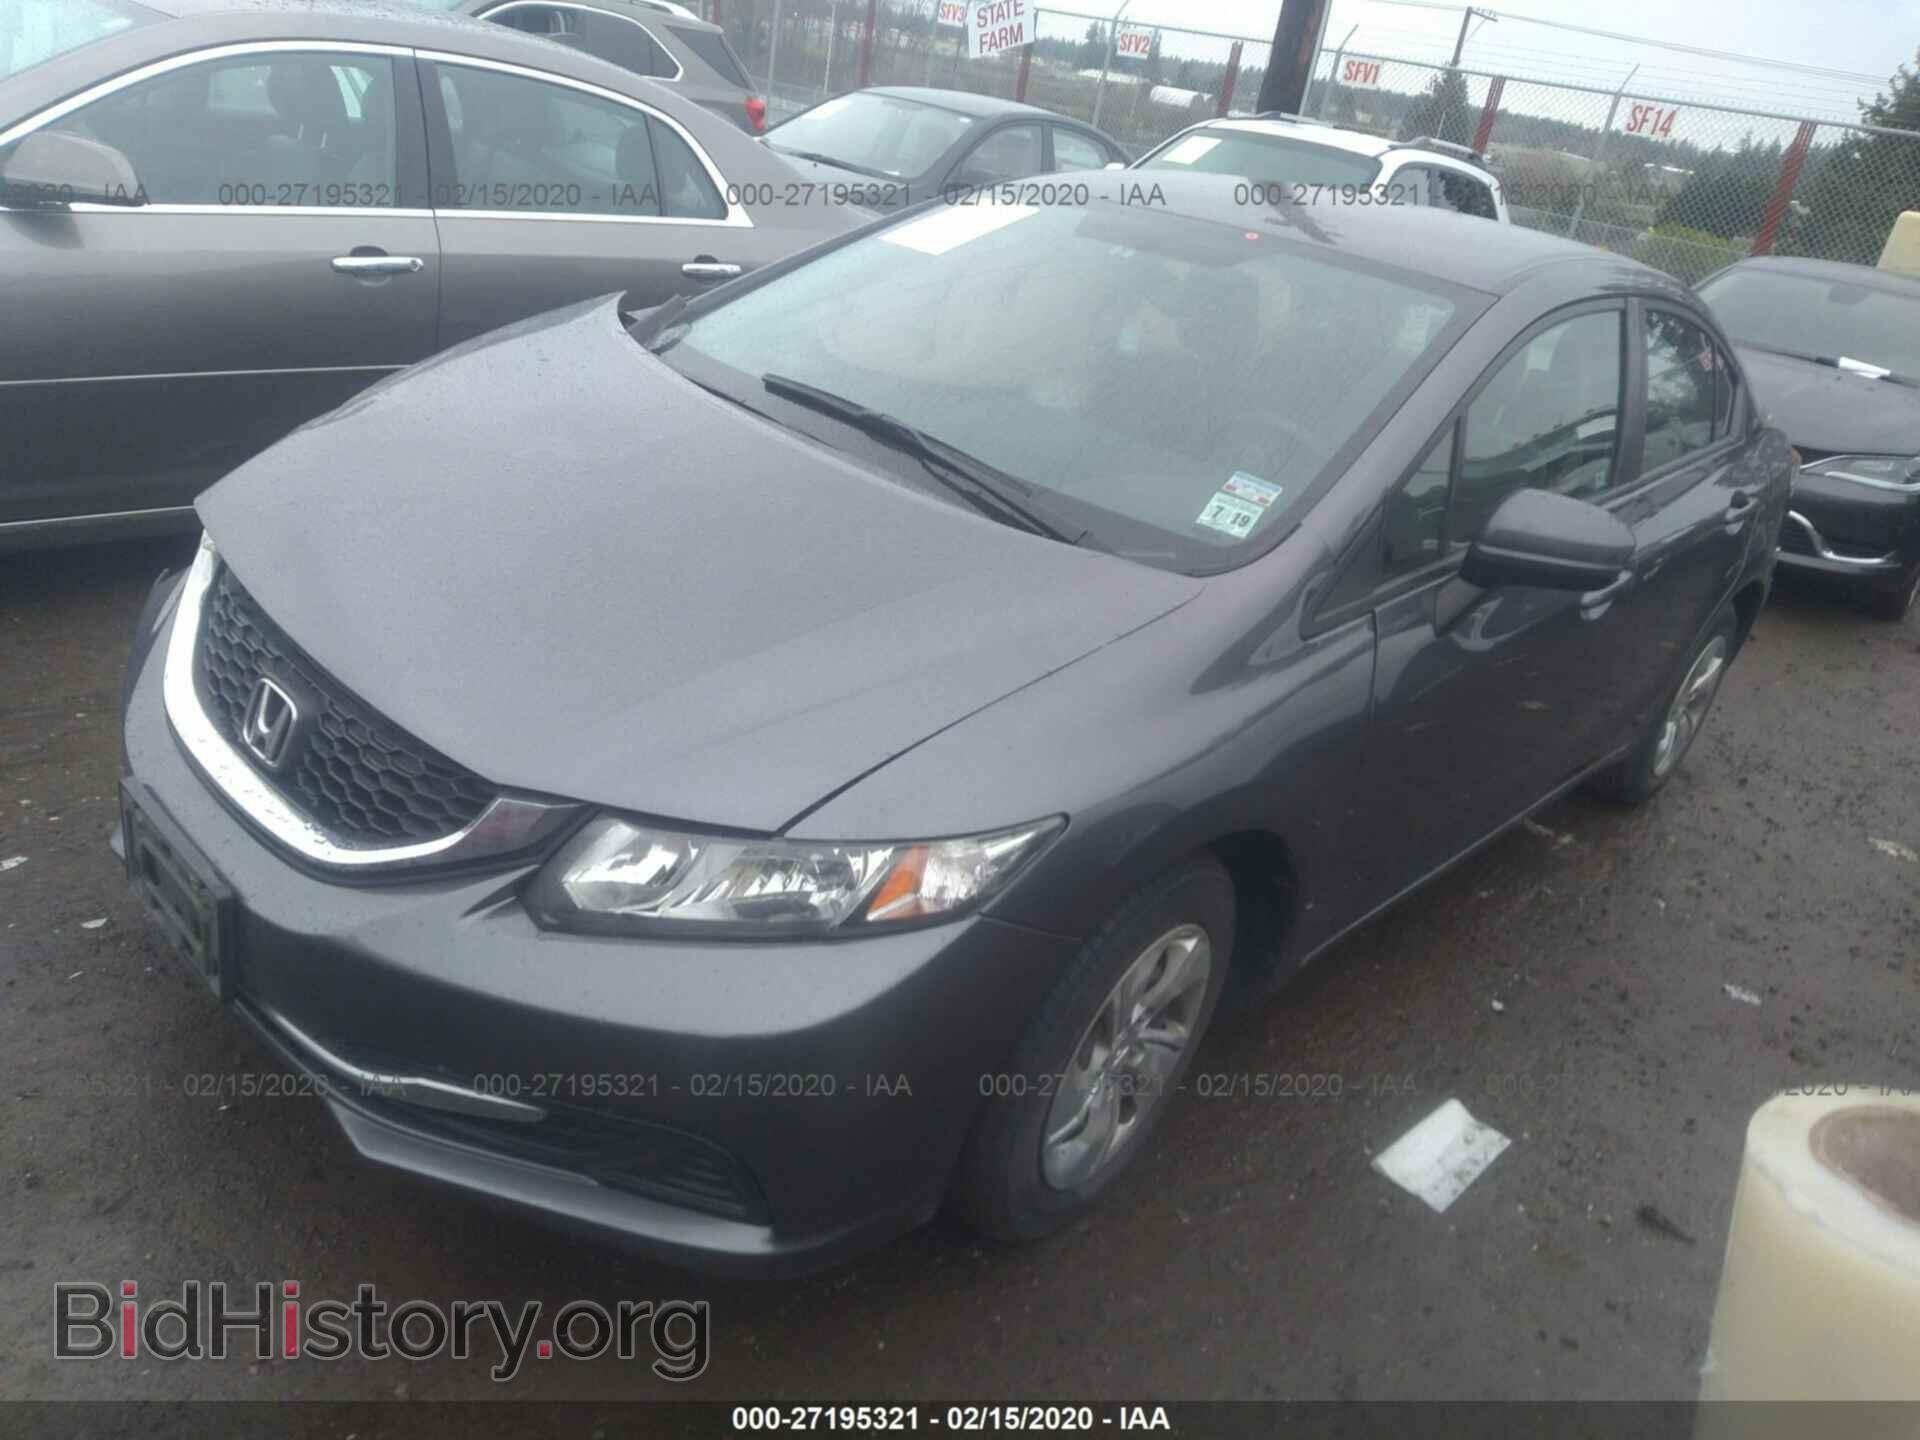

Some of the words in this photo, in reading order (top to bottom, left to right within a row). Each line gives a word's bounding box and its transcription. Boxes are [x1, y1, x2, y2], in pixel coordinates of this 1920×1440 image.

[977, 0, 1024, 28] STATE
[979, 23, 1024, 54] FARM
[1120, 33, 1150, 53] SFV2
[1344, 60, 1380, 84] SFV1
[1626, 104, 1677, 137] SF14
[1211, 505, 1225, 518] 7
[1230, 512, 1251, 527] 19
